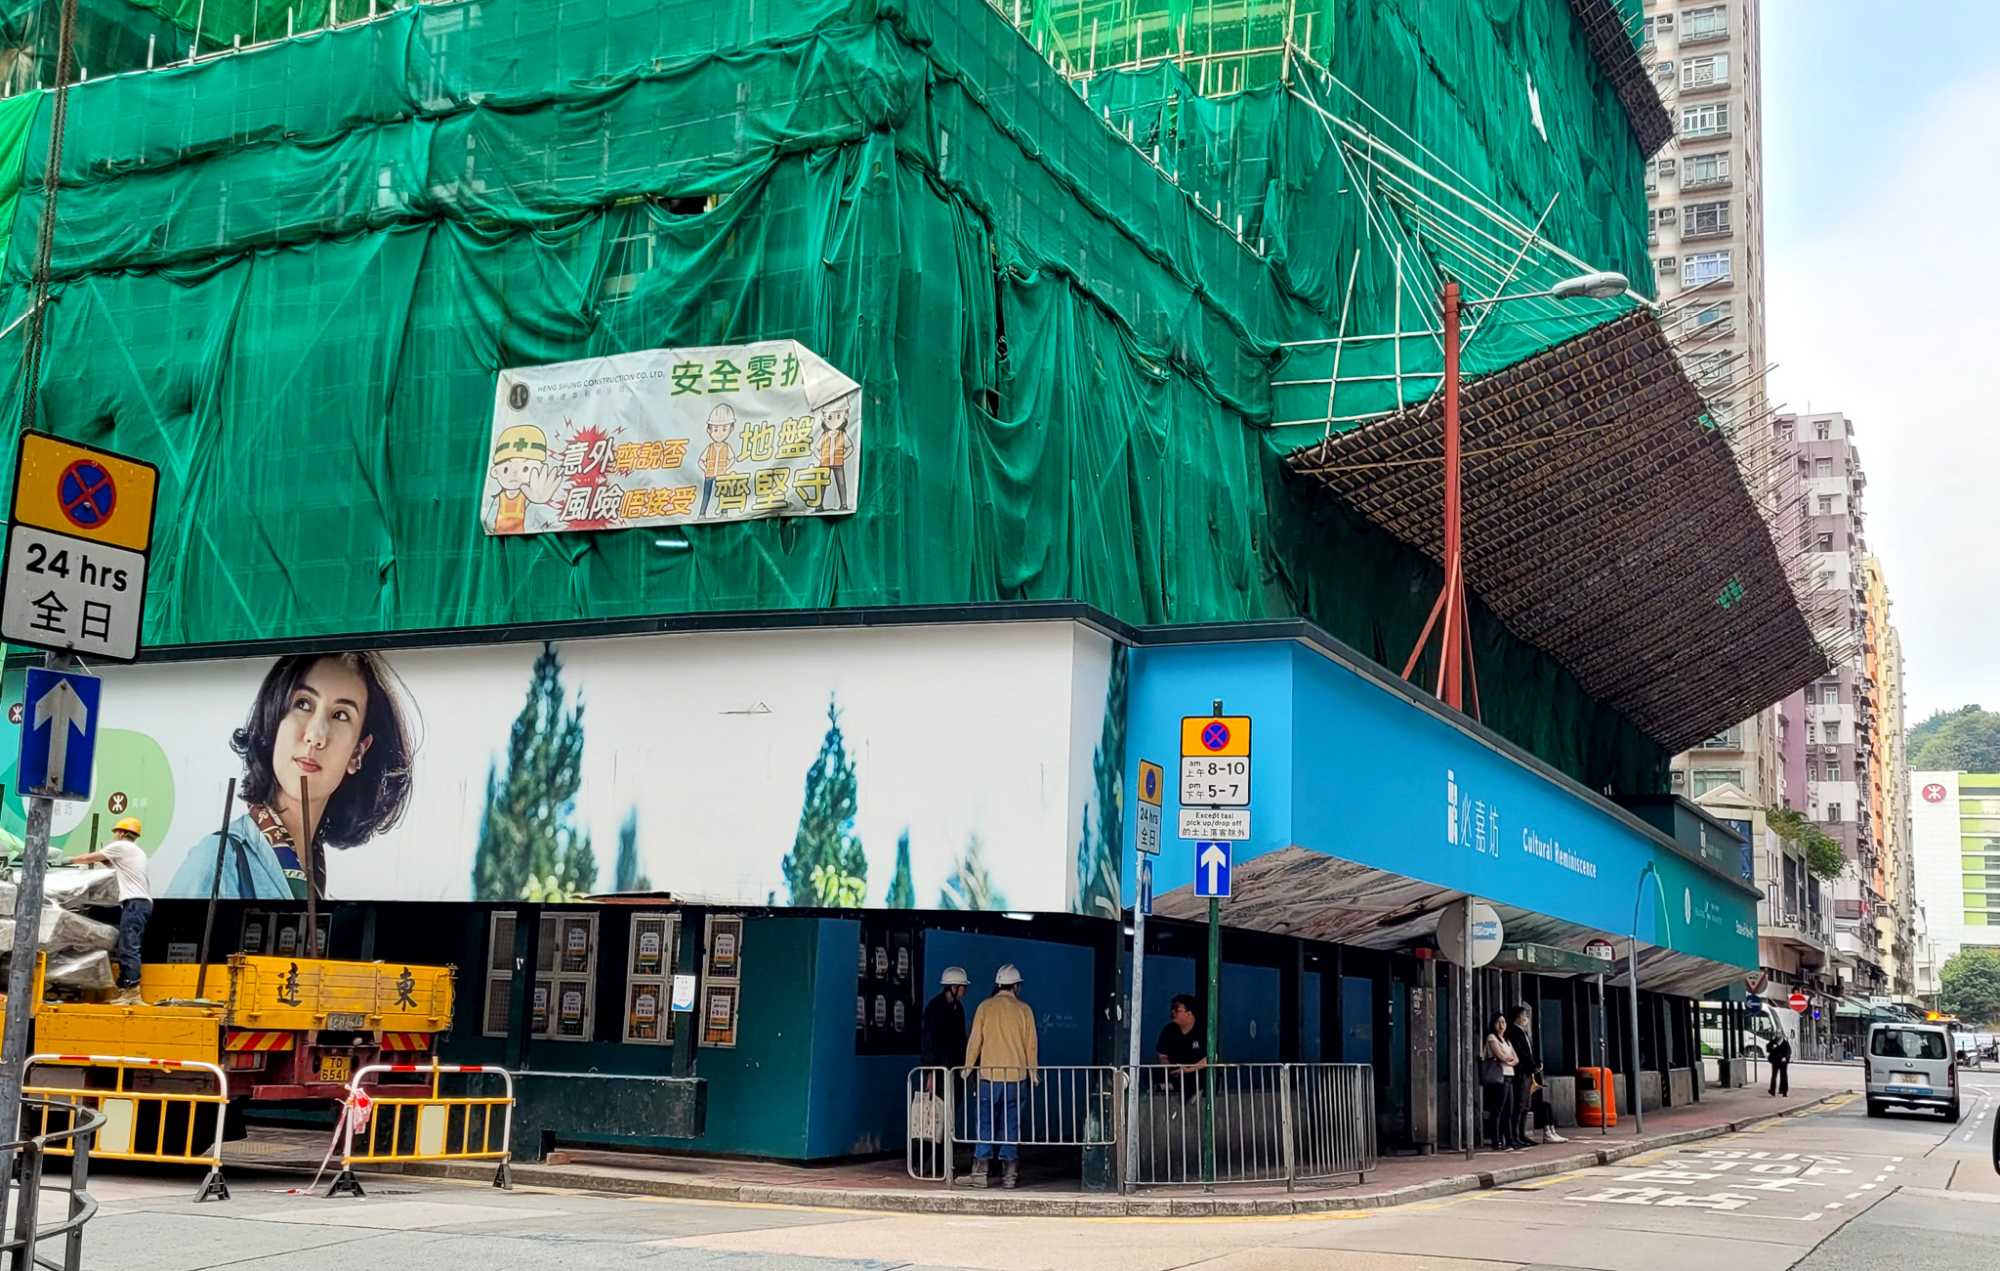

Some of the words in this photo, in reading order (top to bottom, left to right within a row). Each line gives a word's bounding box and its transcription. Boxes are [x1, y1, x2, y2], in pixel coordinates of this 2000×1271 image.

[583, 374, 635, 388] CONSTRUCTION
[736, 415, 815, 462] 地盤
[715, 464, 832, 514] 齊堅守
[26, 543, 70, 579] 24
[80, 554, 128, 592] hrs
[30, 590, 112, 643] 全日
[1185, 768, 1204, 778] 上午
[1208, 762, 1246, 776] 8-10
[1185, 791, 1204, 800] 下午
[1140, 807, 1149, 821] 24
[1149, 811, 1159, 825] hrs
[1195, 812, 1219, 820] Except
[1202, 820, 1230, 828] up/drop
[1460, 792, 1500, 858] 必嘉坊
[1141, 827, 1156, 847] 全日
[1522, 827, 1553, 862] Cultural
[1554, 841, 1598, 879] Reminiscence
[322, 1068, 347, 1081] 6541
[1696, 1150, 1852, 1164] BUS
[1647, 1159, 1853, 1176] STOP
[1612, 1169, 1825, 1192] 巴士
[1563, 1187, 1759, 1210] 站
